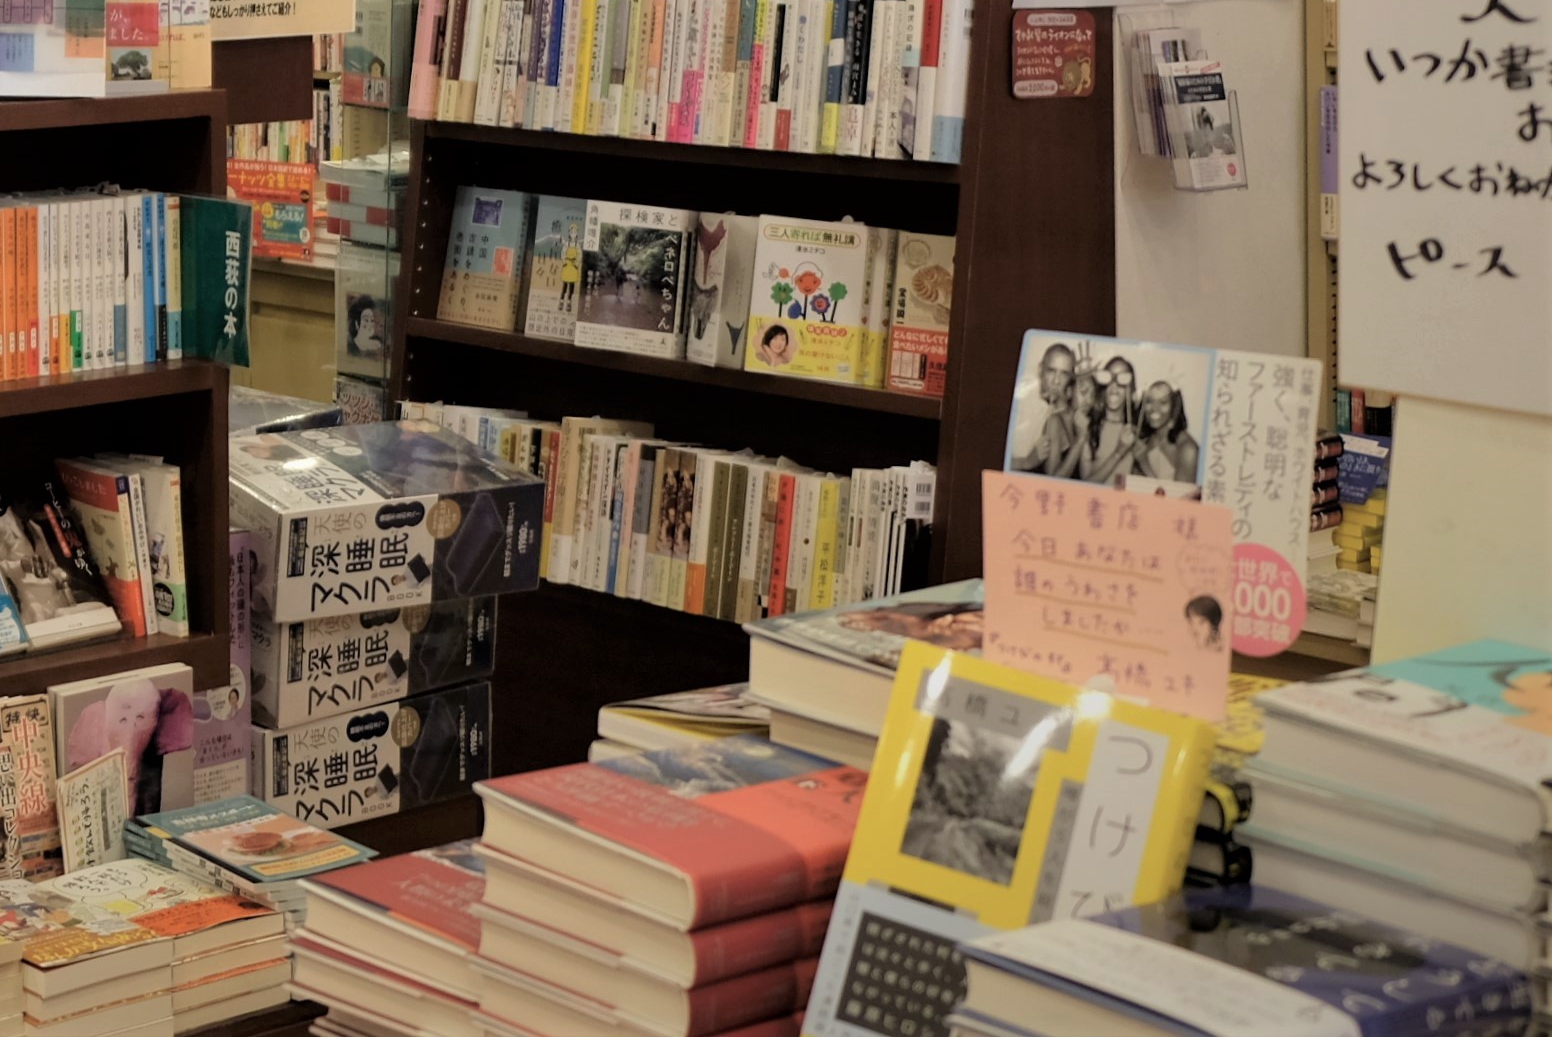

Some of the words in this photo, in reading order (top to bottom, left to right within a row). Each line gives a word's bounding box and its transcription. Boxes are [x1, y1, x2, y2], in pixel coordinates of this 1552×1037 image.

[1364, 37, 1552, 93] いつか書
[618, 208, 679, 227] 探検家と
[767, 226, 857, 246] 三人寄れば無礼講
[656, 233, 678, 330] ペネロペちゃん
[1386, 237, 1518, 280] ピース
[223, 228, 240, 339] 西荻の本
[1232, 360, 1265, 541] ファーストレディの
[1261, 363, 1297, 503] 強く、聡明な
[312, 509, 369, 536] 天使の
[1000, 482, 1142, 531] 今野書店
[310, 531, 409, 579] 深睡眠
[1011, 528, 1059, 560] 今日
[310, 575, 393, 613] マクラ
[306, 629, 391, 682] 深睡眠
[307, 673, 376, 716] マクラ
[11, 717, 48, 816] 中央線
[293, 742, 379, 797] 深睡眠
[295, 788, 366, 822] マクラ
